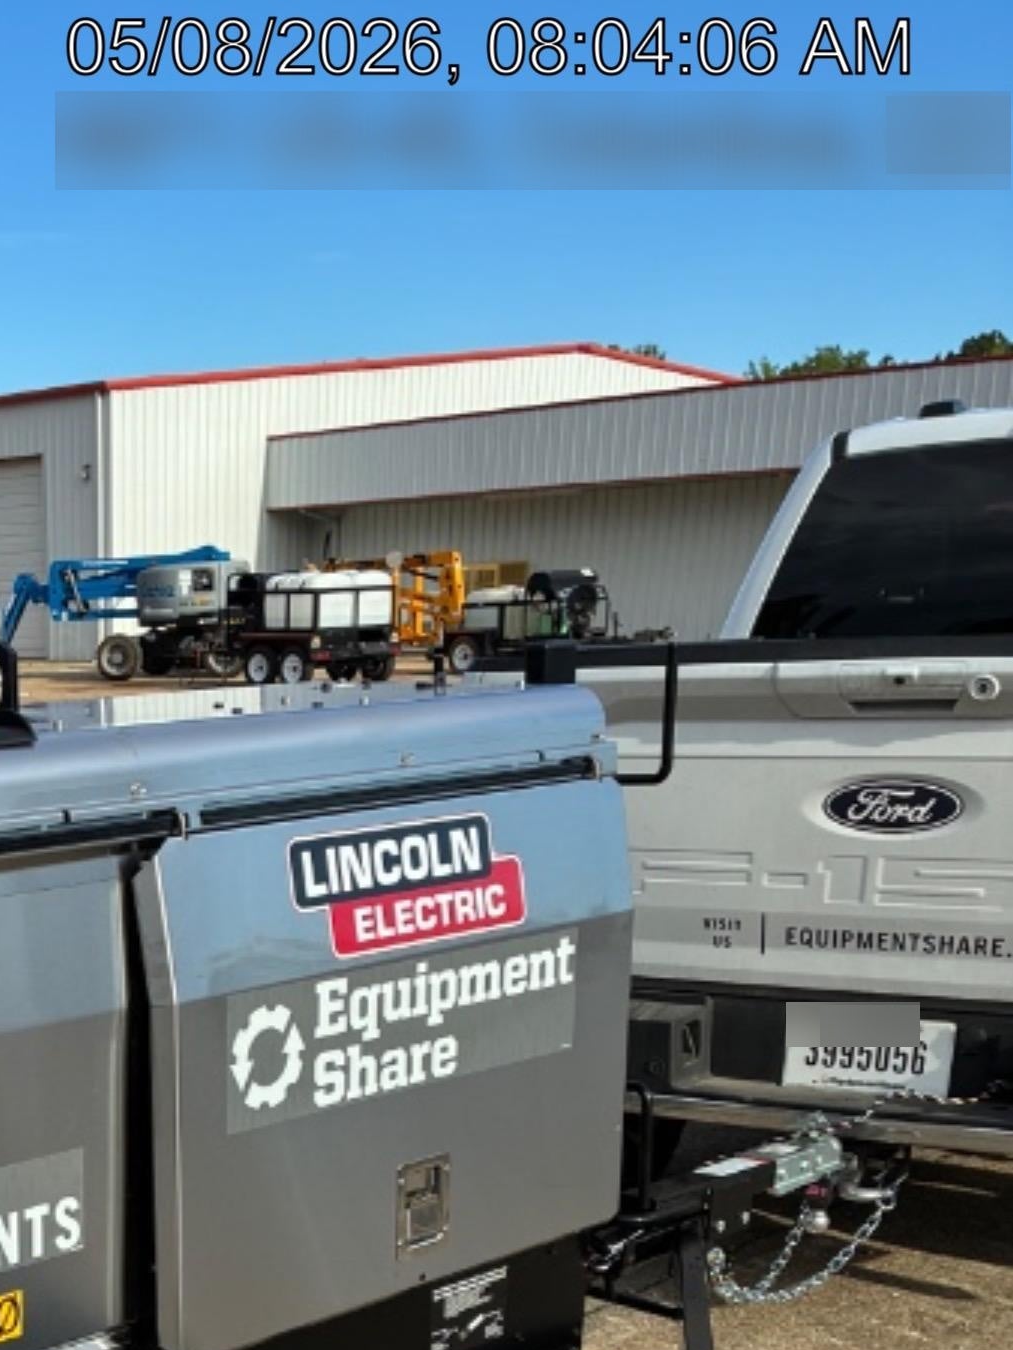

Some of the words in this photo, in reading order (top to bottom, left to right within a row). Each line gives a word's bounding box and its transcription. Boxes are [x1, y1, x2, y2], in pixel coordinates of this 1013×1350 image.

[847, 788, 936, 823] Ford
[301, 827, 481, 898] LINCOLN
[354, 884, 507, 942] ELECTRIC
[702, 917, 742, 932] VISIT
[712, 934, 733, 949] US
[314, 937, 576, 1041] Equipment
[313, 1035, 459, 1108] Share
